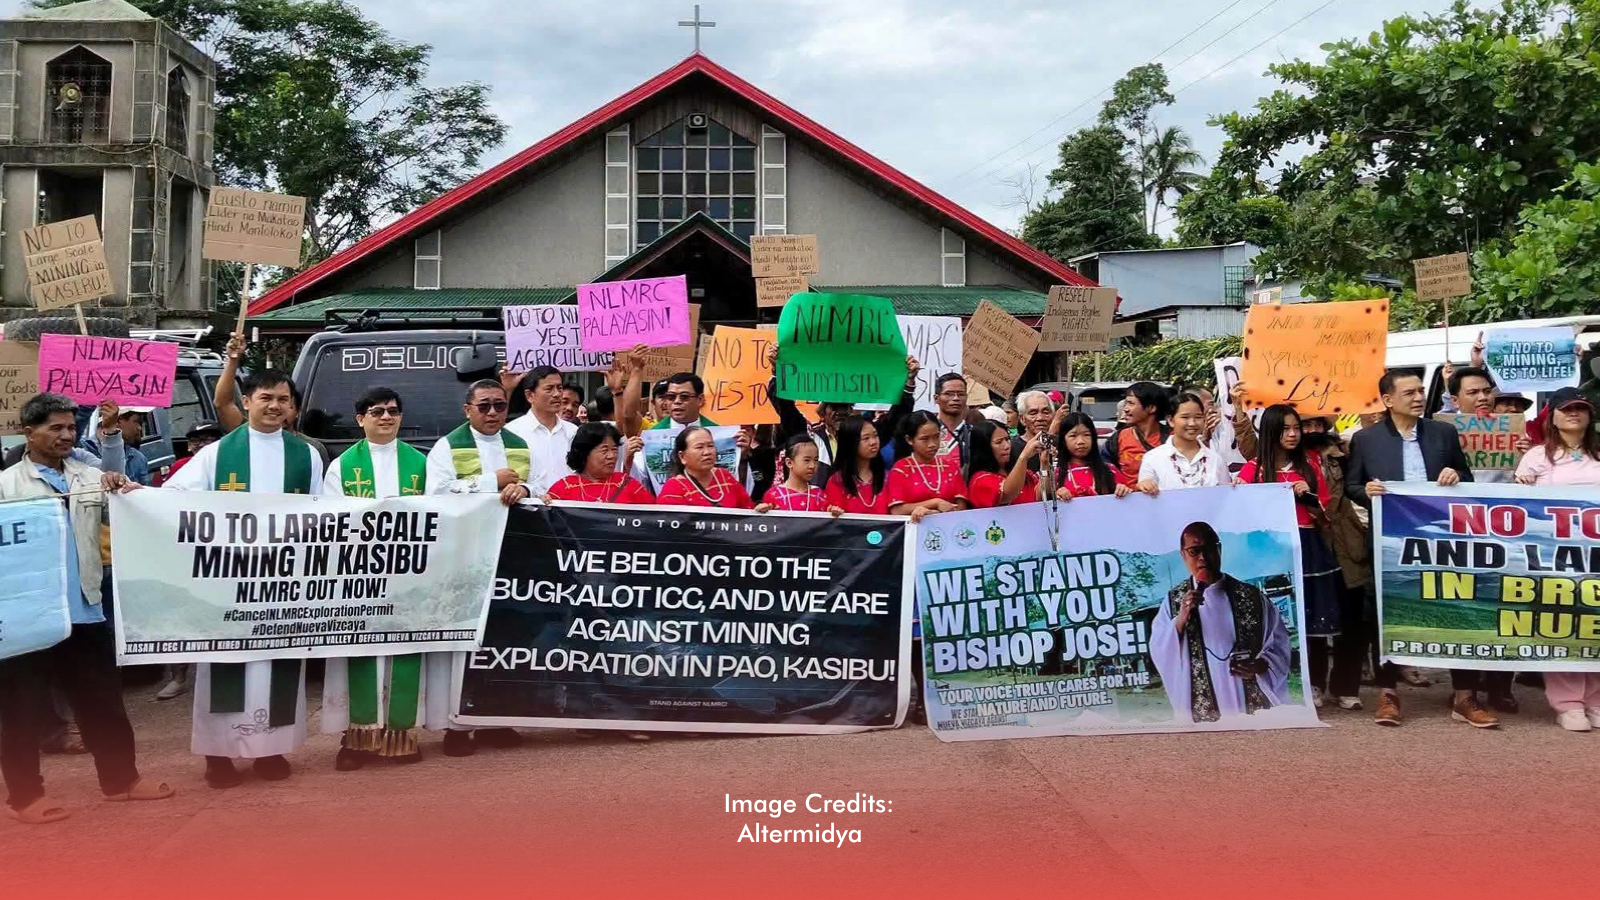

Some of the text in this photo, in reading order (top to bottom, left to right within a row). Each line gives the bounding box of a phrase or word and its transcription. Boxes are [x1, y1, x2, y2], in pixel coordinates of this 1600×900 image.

[210, 206, 239, 219] Lider
[214, 189, 257, 208] Gusto
[24, 222, 85, 253] NO TO
[28, 245, 94, 267] Large Scale
[35, 259, 89, 284] MINING
[41, 274, 107, 304] KASIBU!
[589, 281, 667, 311] NLMRC
[1058, 287, 1094, 303] RESPECT
[507, 308, 531, 329] NO
[532, 307, 555, 324] TO
[583, 307, 672, 337] PALAYASIN!
[793, 304, 894, 345] NLMRC
[72, 339, 150, 362] NLMRC
[536, 327, 567, 346] YES
[1511, 341, 1554, 354] NO TO
[712, 336, 742, 369] NO
[1503, 353, 1561, 366] MINING,
[46, 369, 167, 397] PALAYASIN
[1521, 367, 1537, 378] TO
[1541, 366, 1571, 378] LIFE!
[5, 380, 37, 393] God's
[707, 380, 744, 411] YES
[1283, 374, 1345, 411] Life
[1453, 415, 1510, 432] SAVE
[178, 511, 439, 544] NO TO LARGE-SCALE
[617, 518, 778, 533] NO TO MINING!
[1449, 503, 1527, 537] NO
[192, 544, 428, 578] MINING IN KASIBU
[556, 549, 832, 580] WE BELONG TO THE
[1399, 537, 1506, 569] AND
[235, 577, 387, 603] NLMRC OUT NOW!
[926, 553, 1120, 605] WE STAND
[1421, 571, 1476, 600] IN
[491, 577, 890, 615] BUGKALOT ICC, AND WE ARE
[223, 604, 394, 622] #CancelNLMRCExplorationPermit
[929, 587, 1116, 637] WITH YOU
[162, 642, 178, 652] CEC
[326, 634, 352, 645] VALLEY
[412, 631, 440, 641] VIZCAYA
[251, 618, 366, 637] #DefendNuevaVizcaya
[567, 617, 810, 645] AGAINST MINING
[933, 621, 1148, 673] BISHOP JOSE!
[1391, 640, 1506, 658] PROTECT
[1518, 644, 1568, 658] OUR
[469, 647, 896, 682] EXPLORATION IN PAO, KASIBU!
[938, 672, 1149, 704] YOUR VOICE TRULY CARES FOR THE
[976, 692, 1113, 717] NATURE AND FUTURE.
